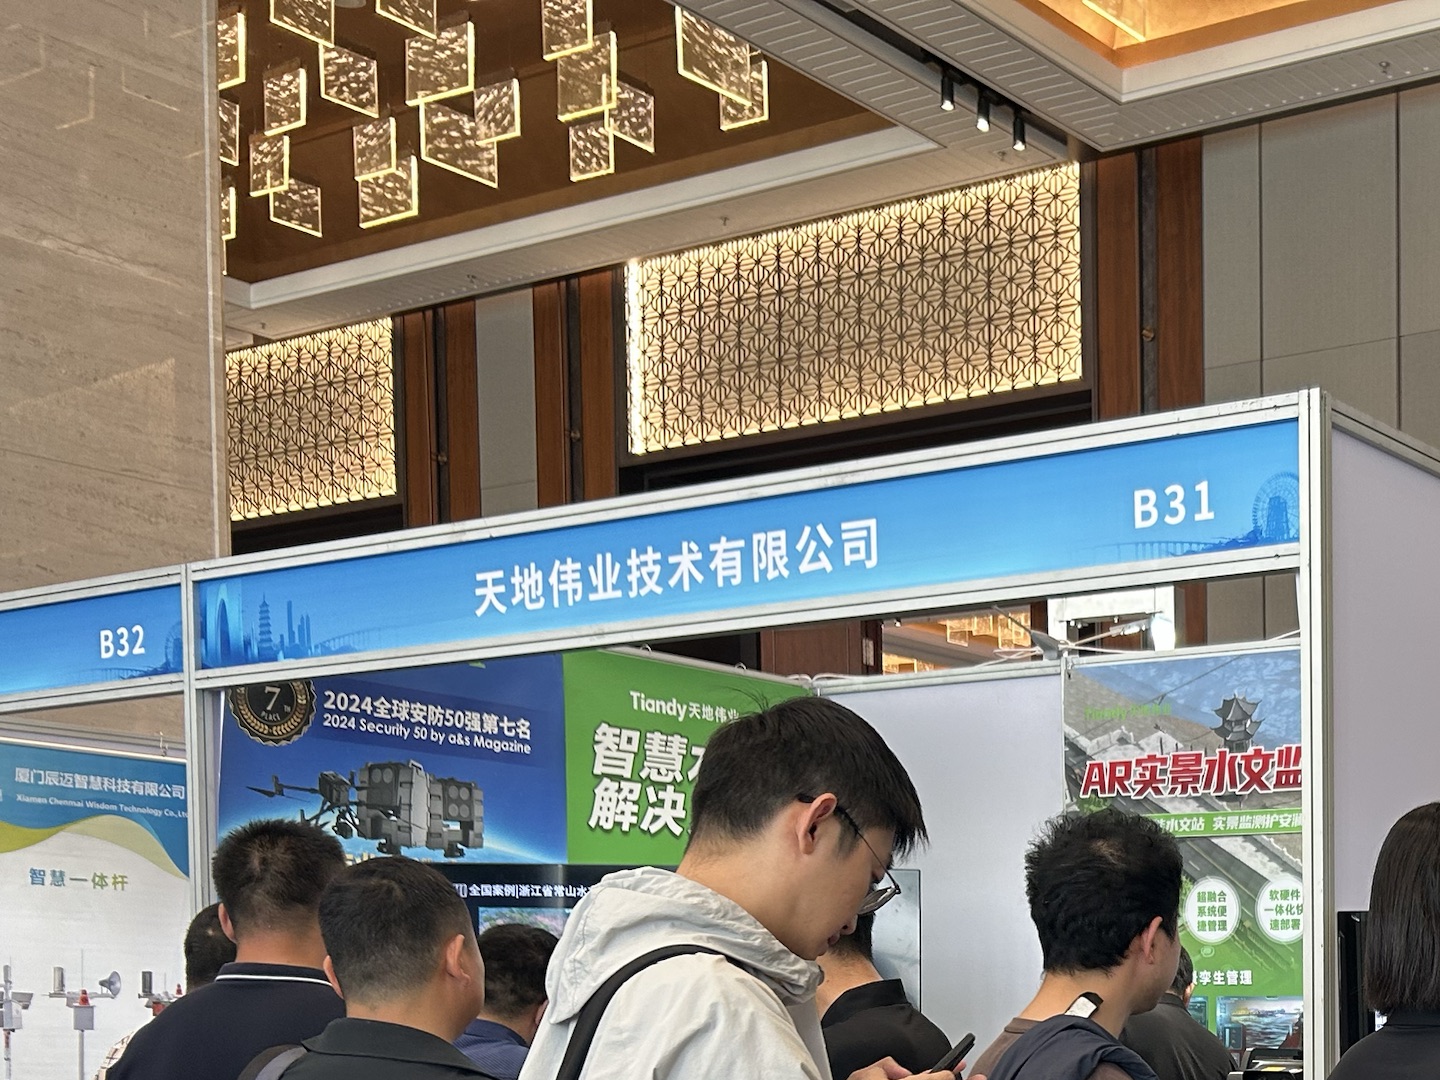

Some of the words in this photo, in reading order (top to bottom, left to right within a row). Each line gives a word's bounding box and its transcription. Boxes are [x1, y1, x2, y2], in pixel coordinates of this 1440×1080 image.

[1132, 480, 1215, 530] B31
[473, 517, 879, 618] 天地伟业技术有限公司
[99, 625, 146, 660] B32
[264, 686, 281, 711] 7
[323, 690, 531, 741] 2024全球安防50强第七名
[629, 690, 688, 722] Tiandy
[323, 712, 356, 729] 2024
[359, 718, 411, 738] Security
[413, 726, 428, 741] 50
[430, 728, 446, 746] by
[448, 733, 471, 747] a&s
[474, 737, 531, 756] Magazine
[15, 767, 186, 800] 厦门辰迈智慧科技有限公司
[1080, 743, 1302, 800] AR实景水文监
[16, 793, 47, 805] Xiamen
[49, 796, 84, 808] Chenmai
[86, 800, 118, 811] Wisdom
[119, 803, 163, 818] Technology
[588, 777, 693, 837] 解决
[29, 867, 129, 891] 智慧一体杆
